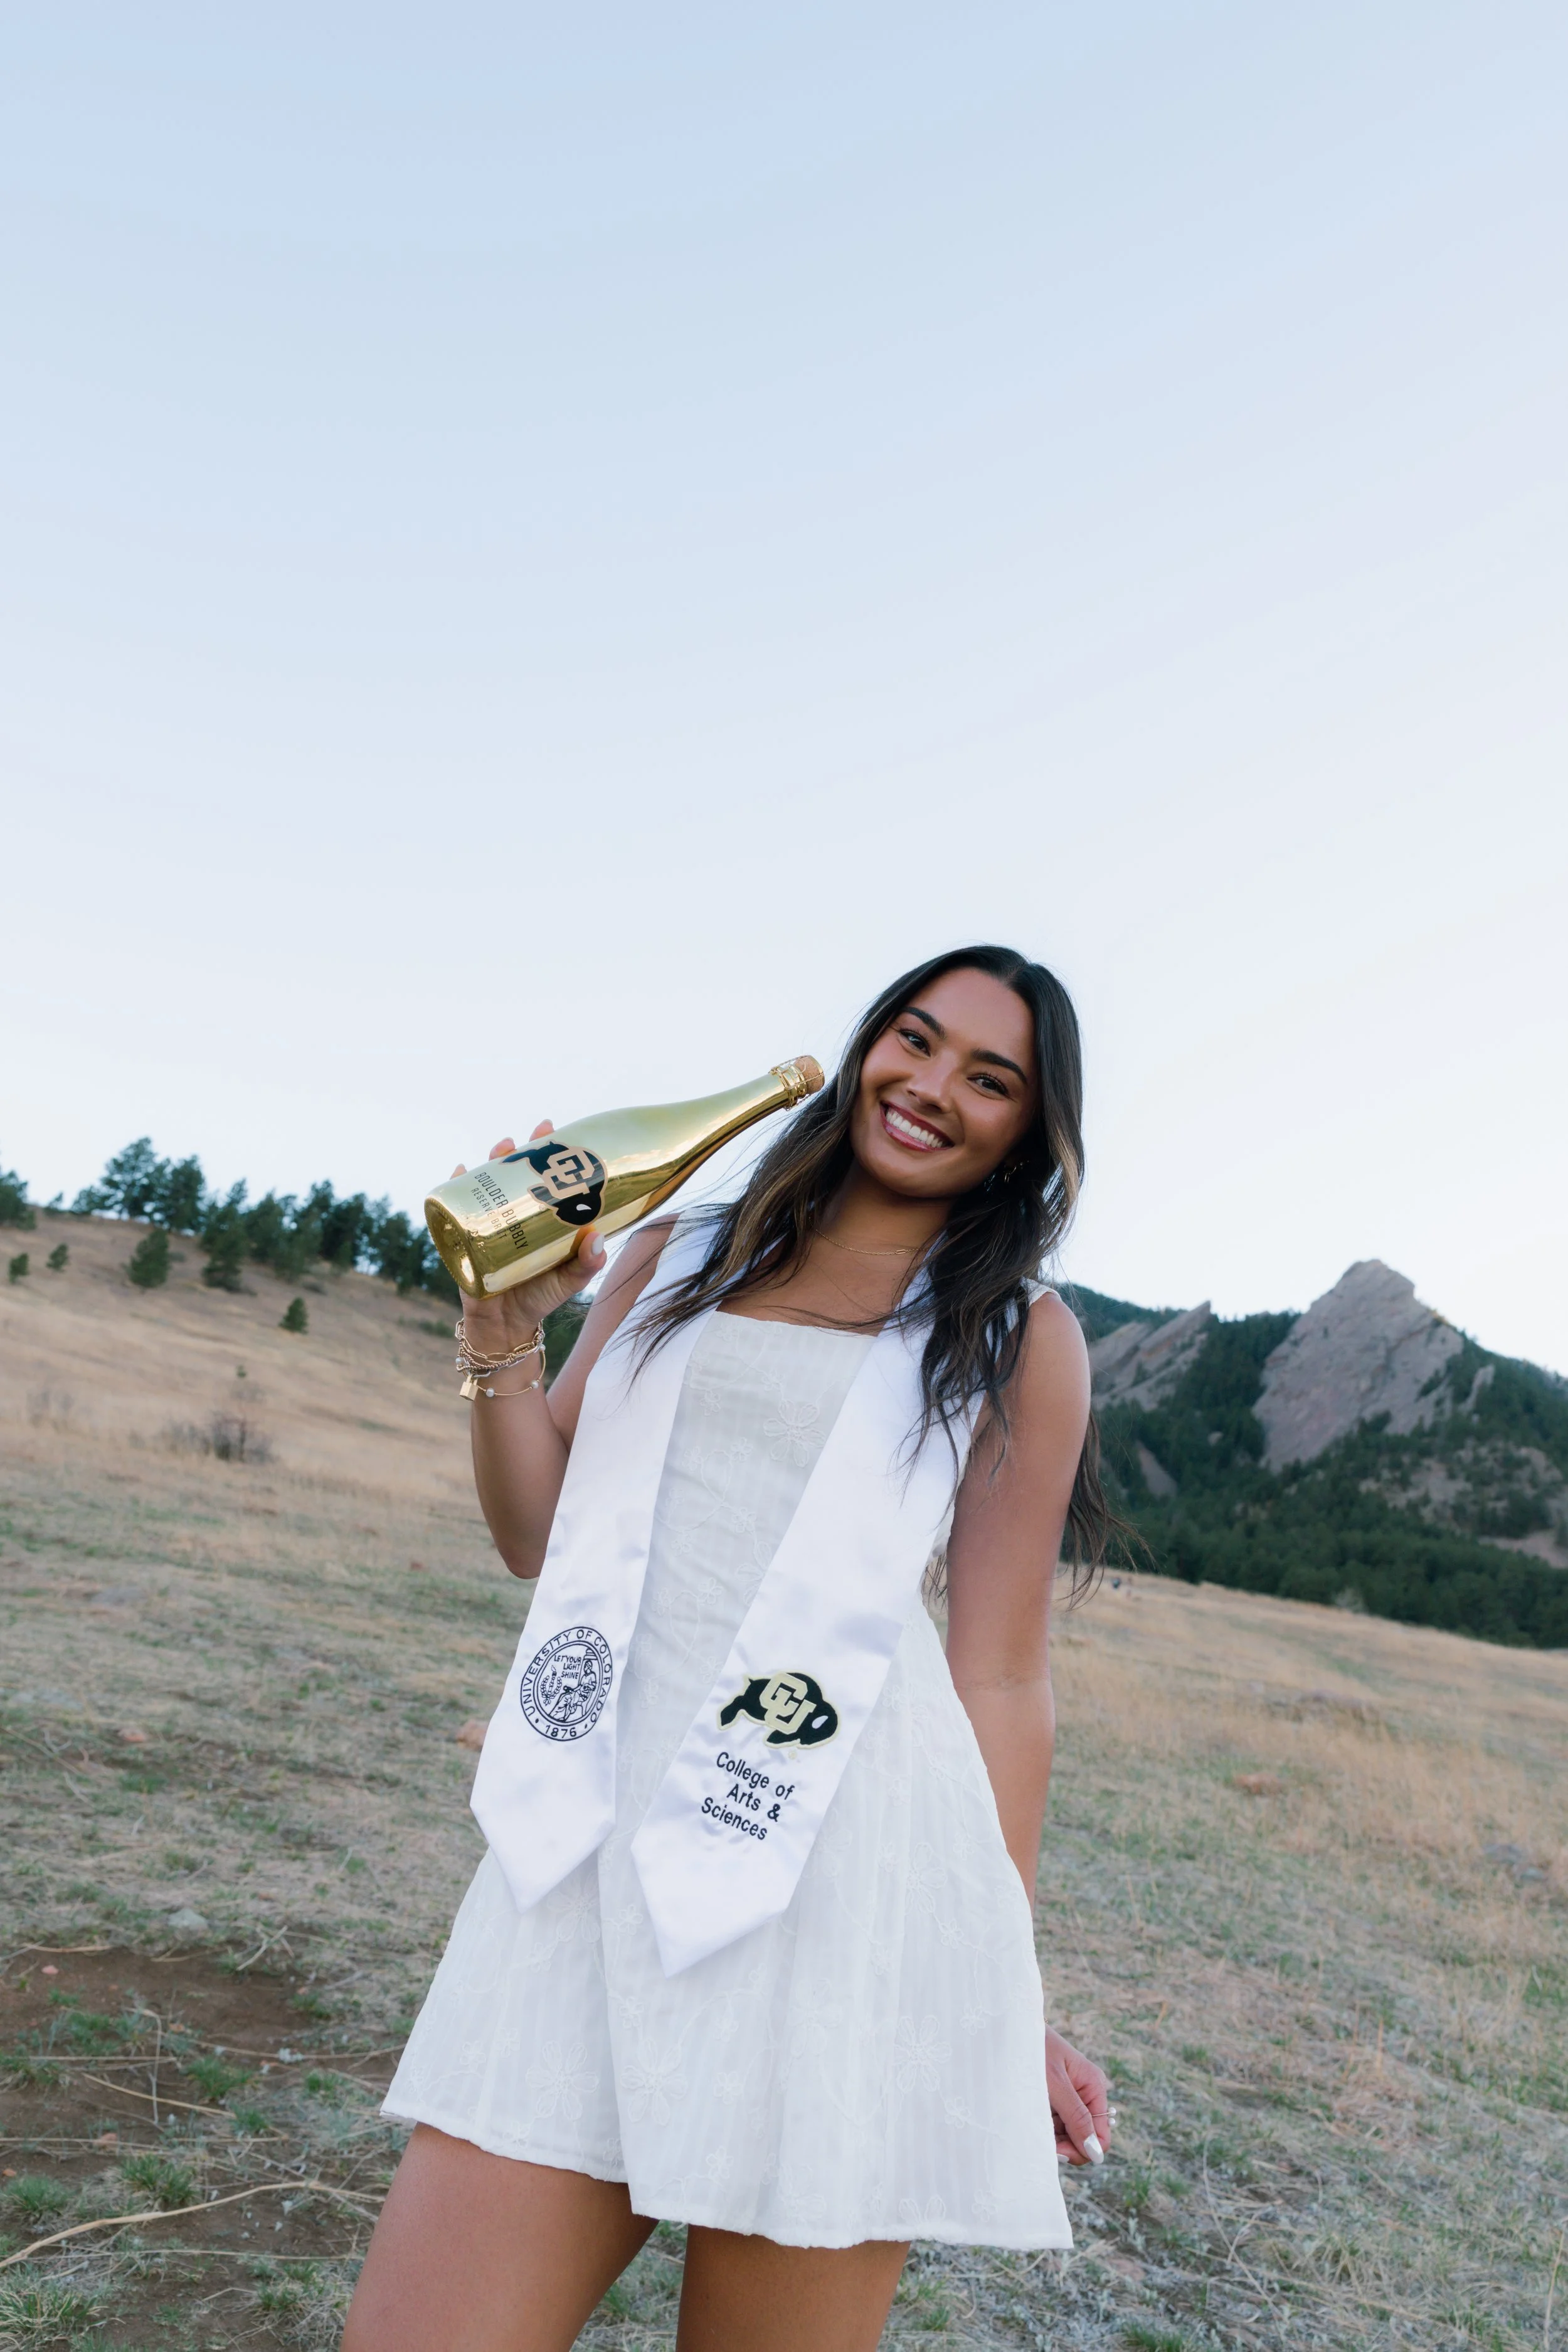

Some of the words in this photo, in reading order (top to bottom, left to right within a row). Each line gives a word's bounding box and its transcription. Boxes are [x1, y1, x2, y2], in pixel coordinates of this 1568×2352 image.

[470, 1187, 495, 1217] RESERVE
[491, 1217, 507, 1239] BRUT
[474, 1172, 509, 1209] BOULDER
[502, 1209, 529, 1250] BUBBLY
[522, 1631, 571, 1717] UNIVERSITY
[576, 1629, 593, 1640] OF
[590, 1636, 612, 1723] COLORADO
[561, 1671, 580, 1680] SHINE
[563, 1663, 581, 1671] LIGHT
[564, 1655, 582, 1663] YOUR
[545, 1724, 577, 1739] 1876
[716, 1751, 770, 1789] College
[775, 1784, 795, 1800] of
[701, 1797, 768, 1840] Sciences
[726, 1783, 761, 1811] Arts
[767, 1803, 781, 1823] &
